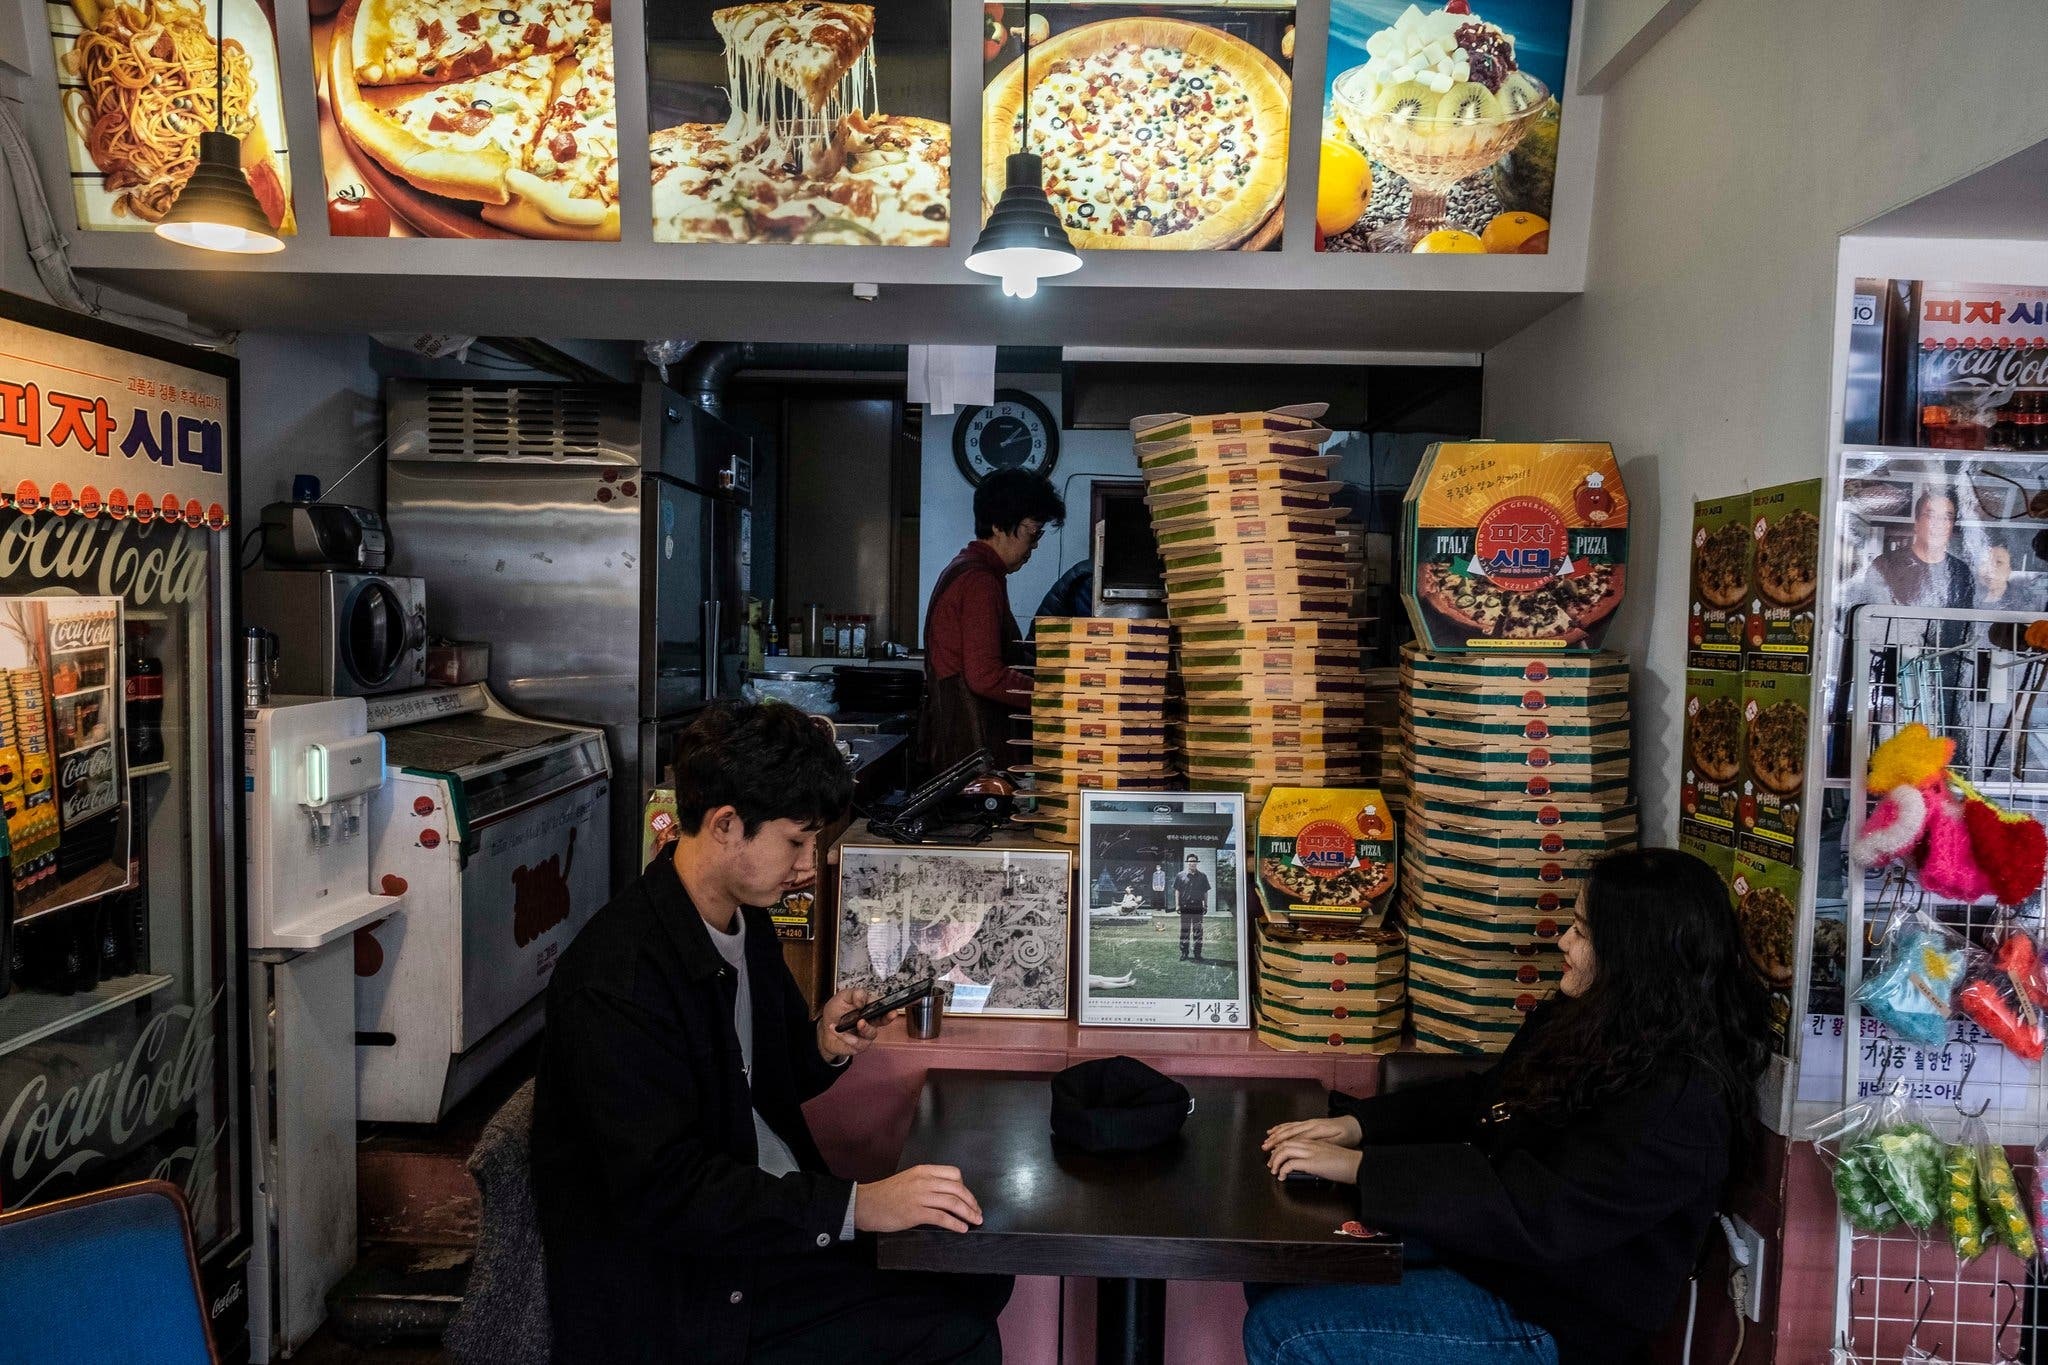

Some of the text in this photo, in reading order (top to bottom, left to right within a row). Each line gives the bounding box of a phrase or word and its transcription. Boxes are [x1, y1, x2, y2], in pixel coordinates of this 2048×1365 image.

[1854, 306, 1873, 320] 10
[1923, 300, 2048, 325] 피자 시
[127, 377, 156, 397] 고품질
[159, 384, 177, 403] 정통
[0, 381, 223, 475] 피자 시대
[1031, 422, 1038, 431] 2
[970, 438, 978, 447] 9
[1034, 439, 1041, 448] 3
[975, 454, 982, 464] 8
[1028, 454, 1036, 464] 4
[1485, 501, 1560, 525] PIZZA GENERATION
[1489, 523, 1555, 543] 피자
[1436, 536, 1469, 554] ITALY
[1576, 536, 1608, 554] PIZZA
[1489, 548, 1550, 568] 시대
[1504, 582, 1529, 590] PIZZA
[652, 813, 671, 830] NEW
[1271, 842, 1292, 853] ITALY
[1304, 836, 1348, 849] 피자
[1360, 844, 1382, 857] PIZZA
[1306, 851, 1346, 864] 시대
[847, 886, 1055, 969] 기생충
[1184, 1001, 1240, 1023] 기생충
[1812, 1015, 1825, 1036] 칸
